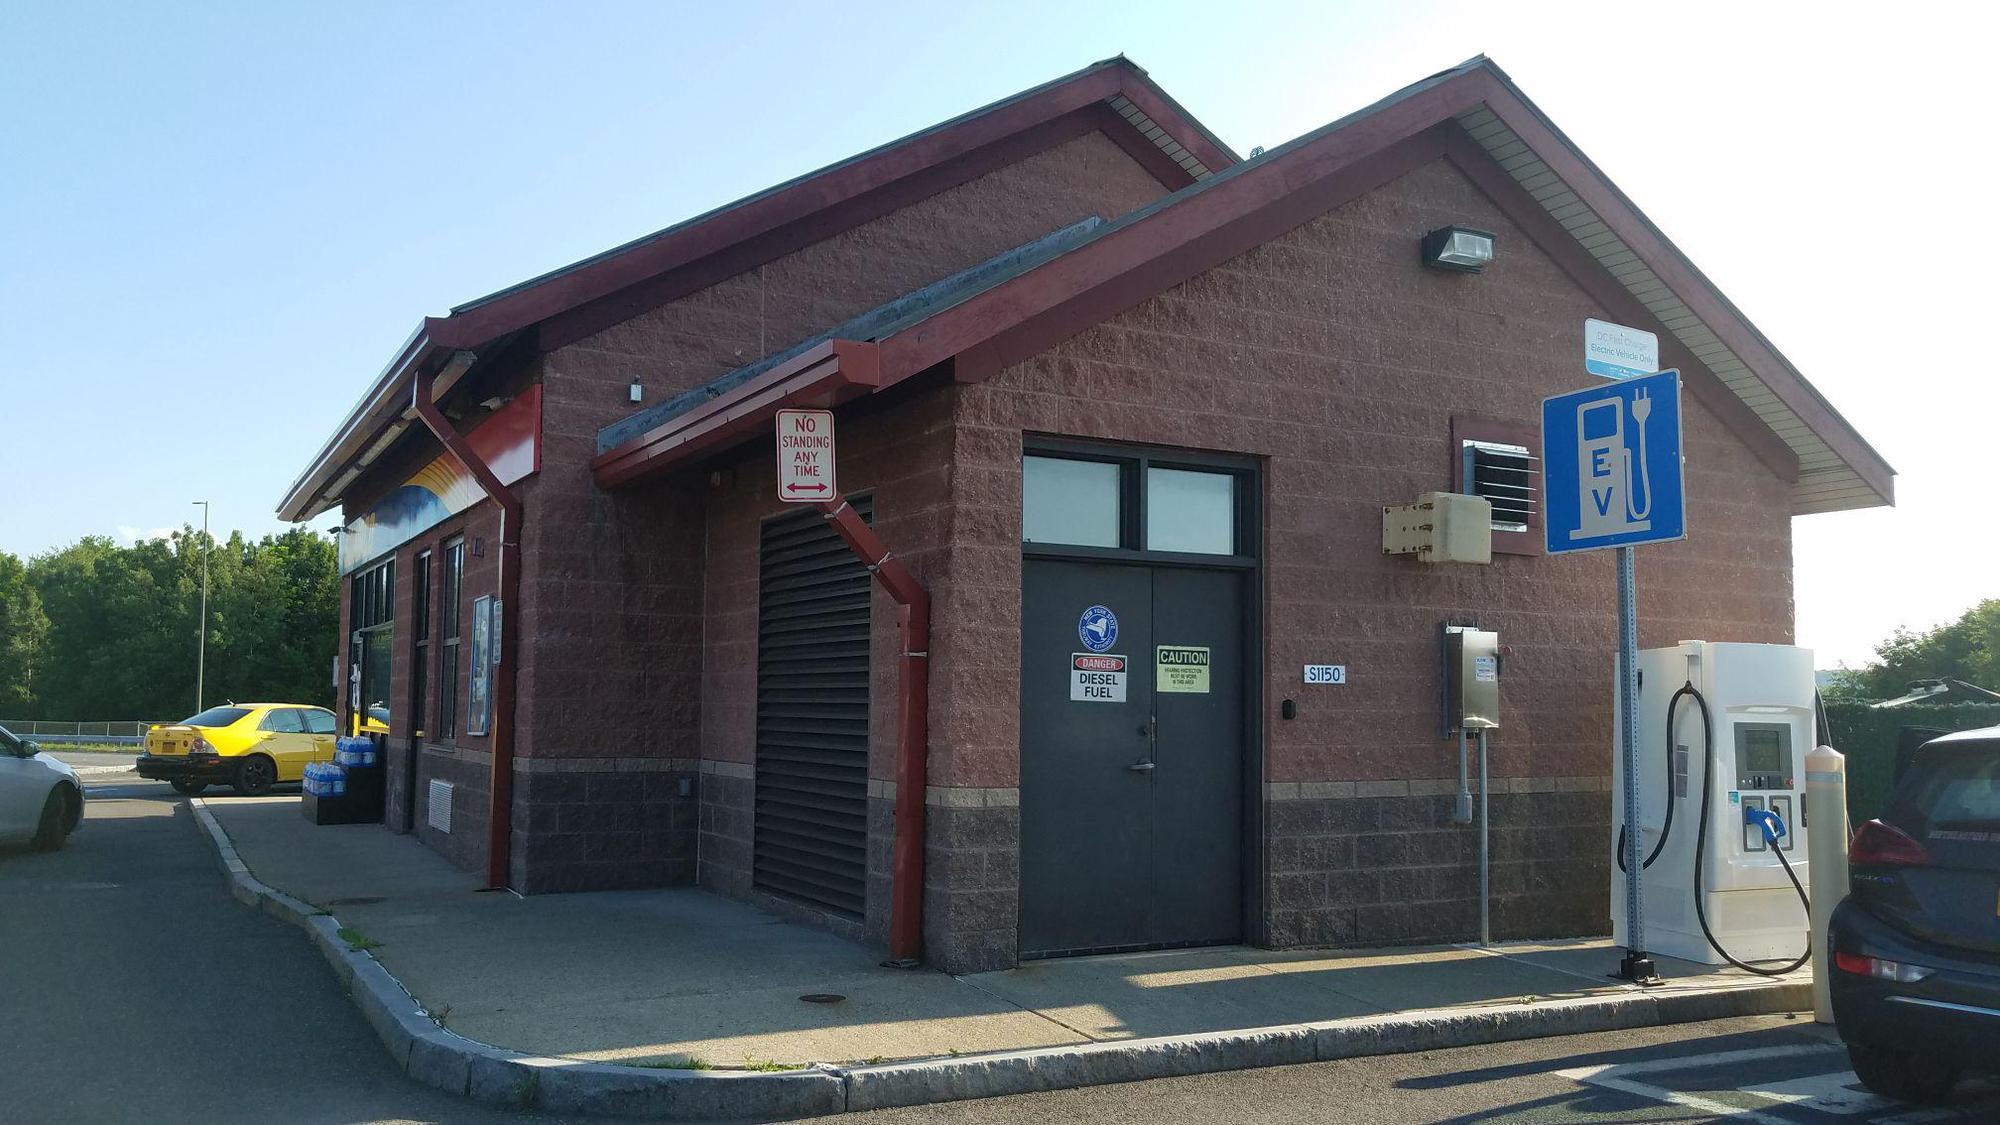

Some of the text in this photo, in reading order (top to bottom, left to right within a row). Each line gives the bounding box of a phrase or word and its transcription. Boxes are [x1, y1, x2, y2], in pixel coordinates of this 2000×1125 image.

[1590, 343, 1654, 365] Electric Vehicle Only
[795, 418, 816, 432] NO
[782, 436, 829, 448] STANDING
[794, 451, 818, 462] ANY
[794, 465, 820, 477] TIME
[1083, 658, 1116, 669] DANGER
[1160, 651, 1207, 664] CAUTION
[1080, 673, 1118, 685] DIESEL
[1309, 667, 1340, 681] S1150
[1085, 687, 1112, 698] FUEL
